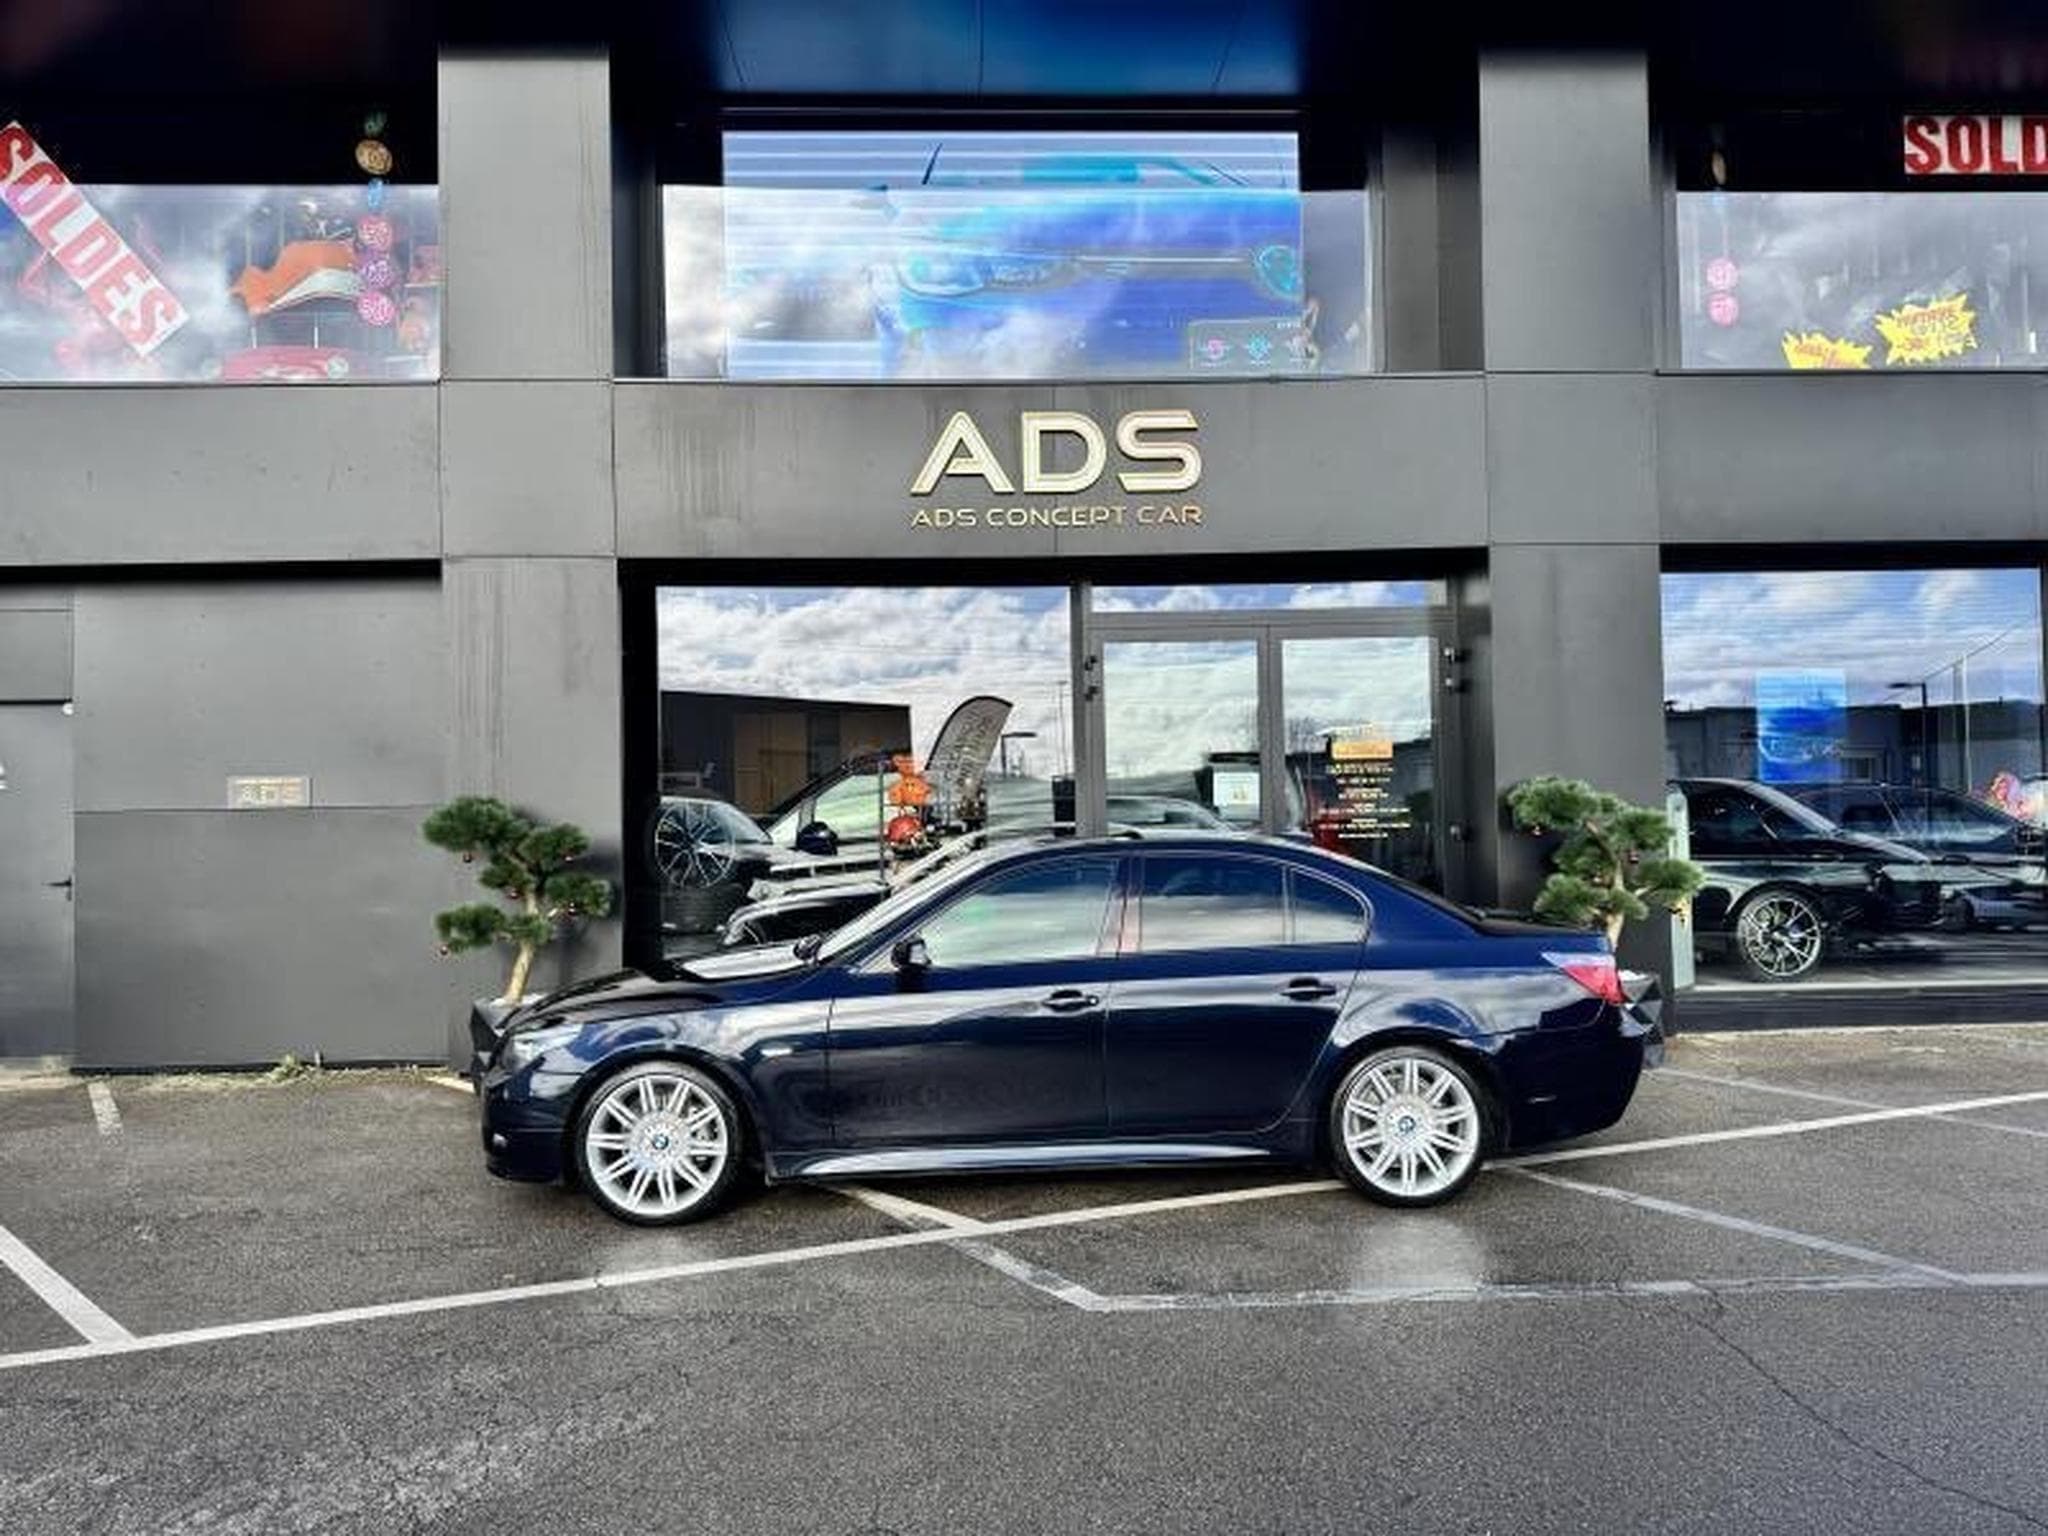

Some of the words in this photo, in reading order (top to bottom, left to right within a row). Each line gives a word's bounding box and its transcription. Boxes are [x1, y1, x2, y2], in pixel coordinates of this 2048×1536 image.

[1906, 115, 2048, 173] SOLD
[0, 126, 178, 345] SOLDES
[909, 409, 1202, 495] ADS
[911, 508, 976, 528] ADS
[985, 505, 1127, 528] CONCEPT
[1135, 505, 1202, 525] CAR
